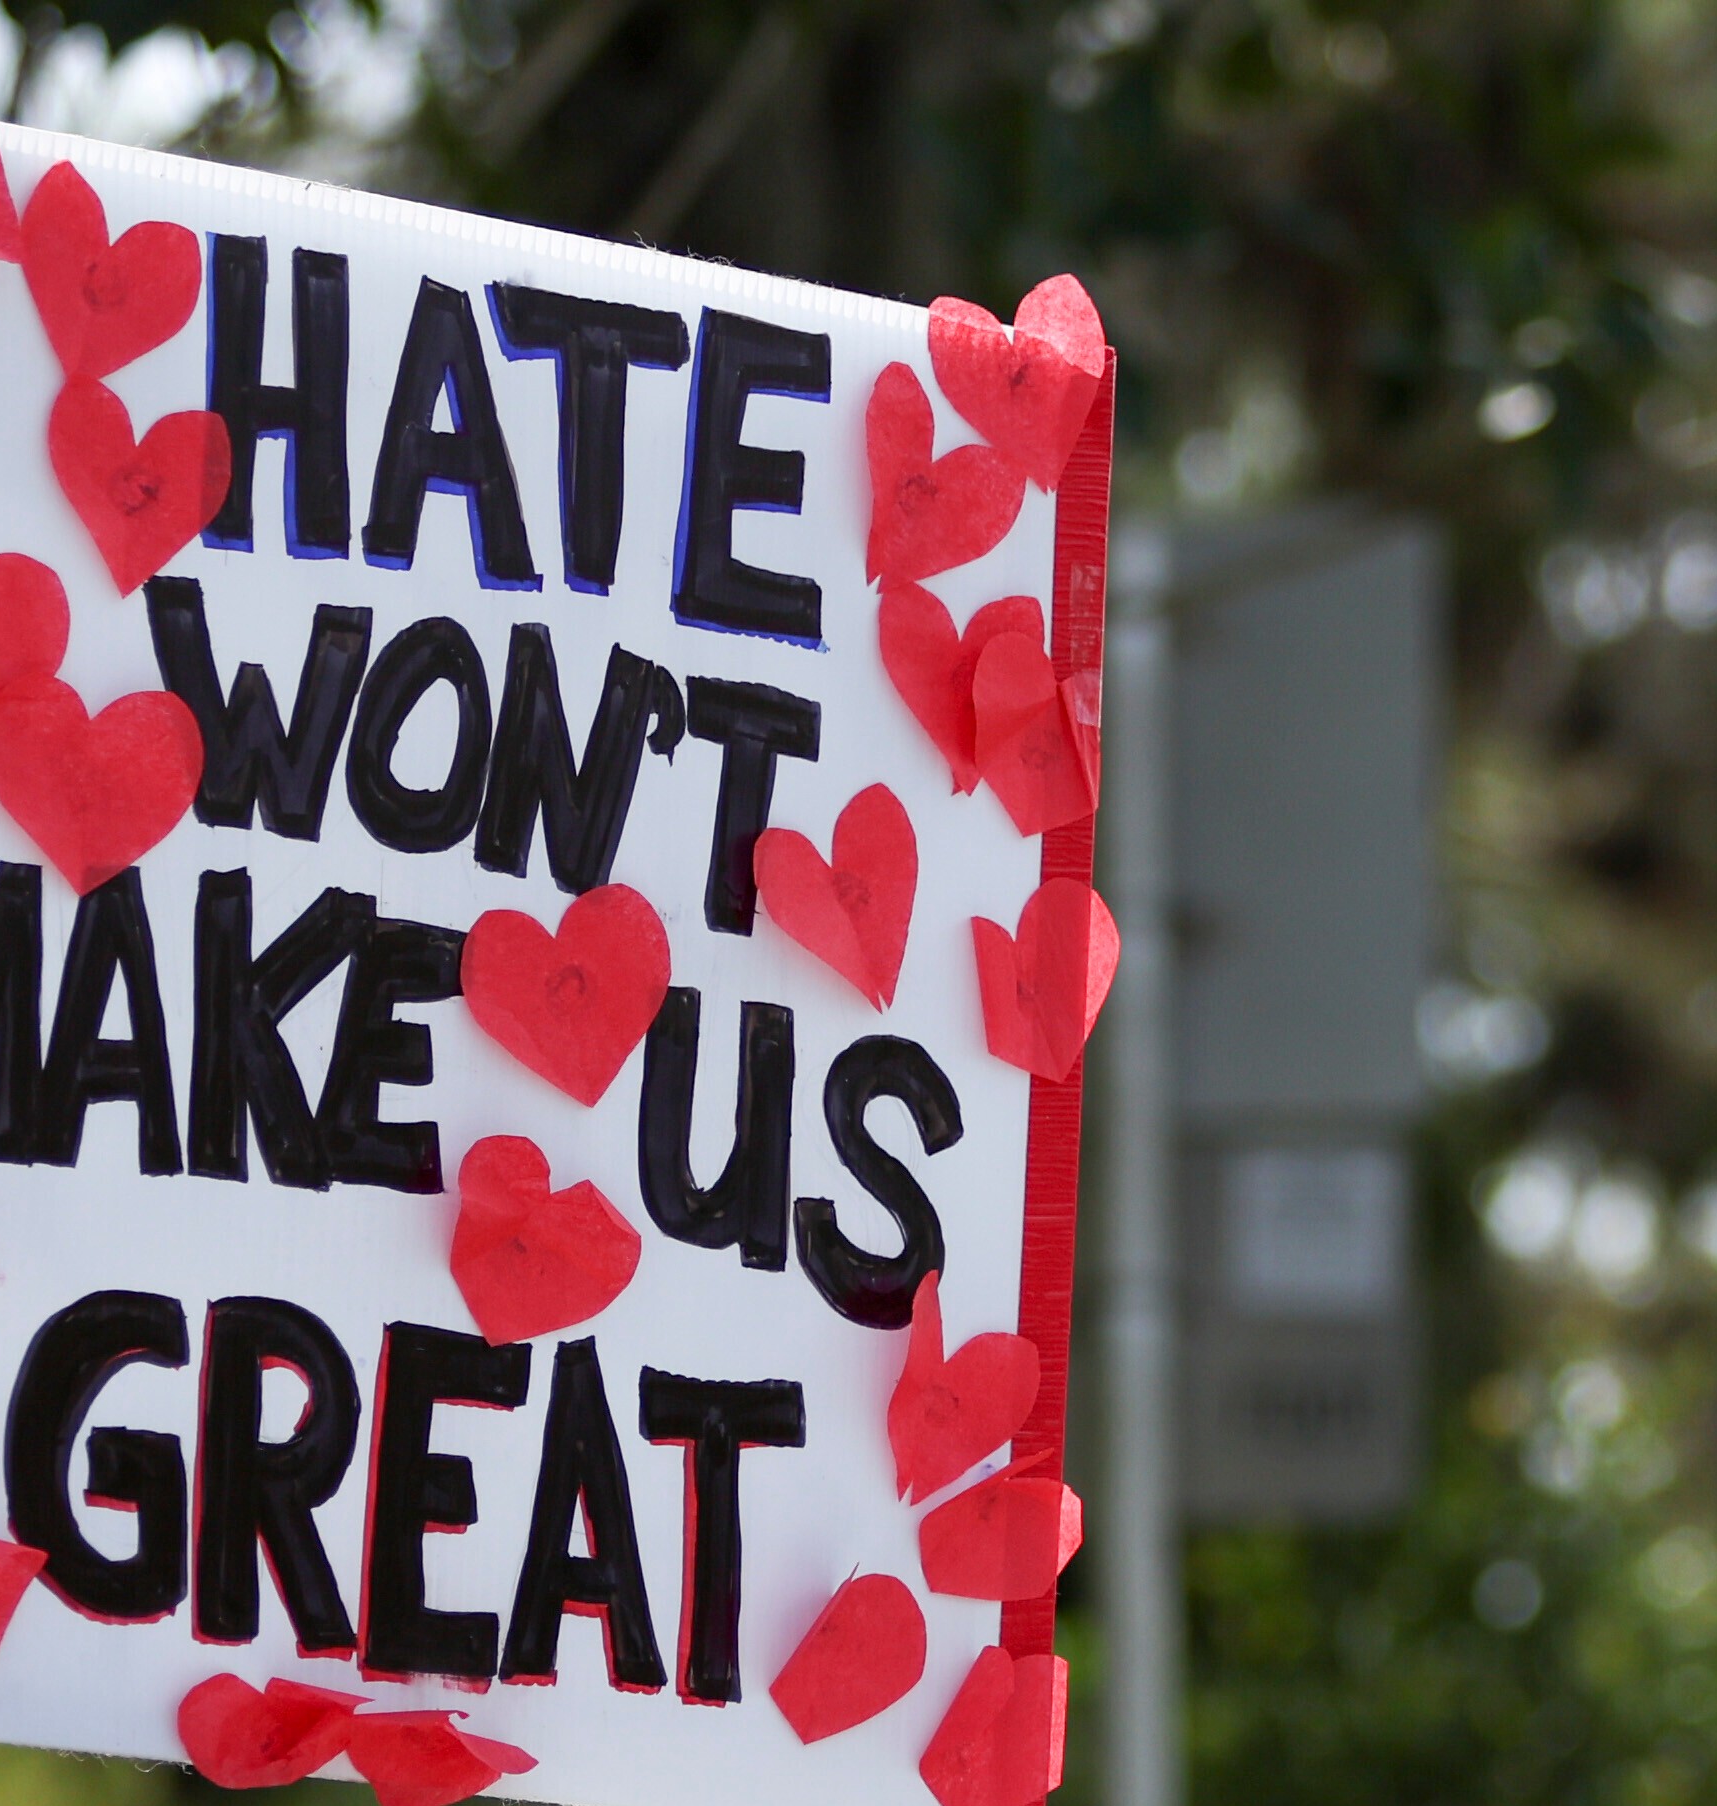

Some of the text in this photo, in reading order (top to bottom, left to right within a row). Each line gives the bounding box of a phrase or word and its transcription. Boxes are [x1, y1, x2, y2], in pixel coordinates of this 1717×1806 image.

[200, 230, 833, 653] HATE
[144, 575, 823, 937] WON'T
[637, 985, 966, 1331] US
[4, 1289, 807, 1708] GREAT
